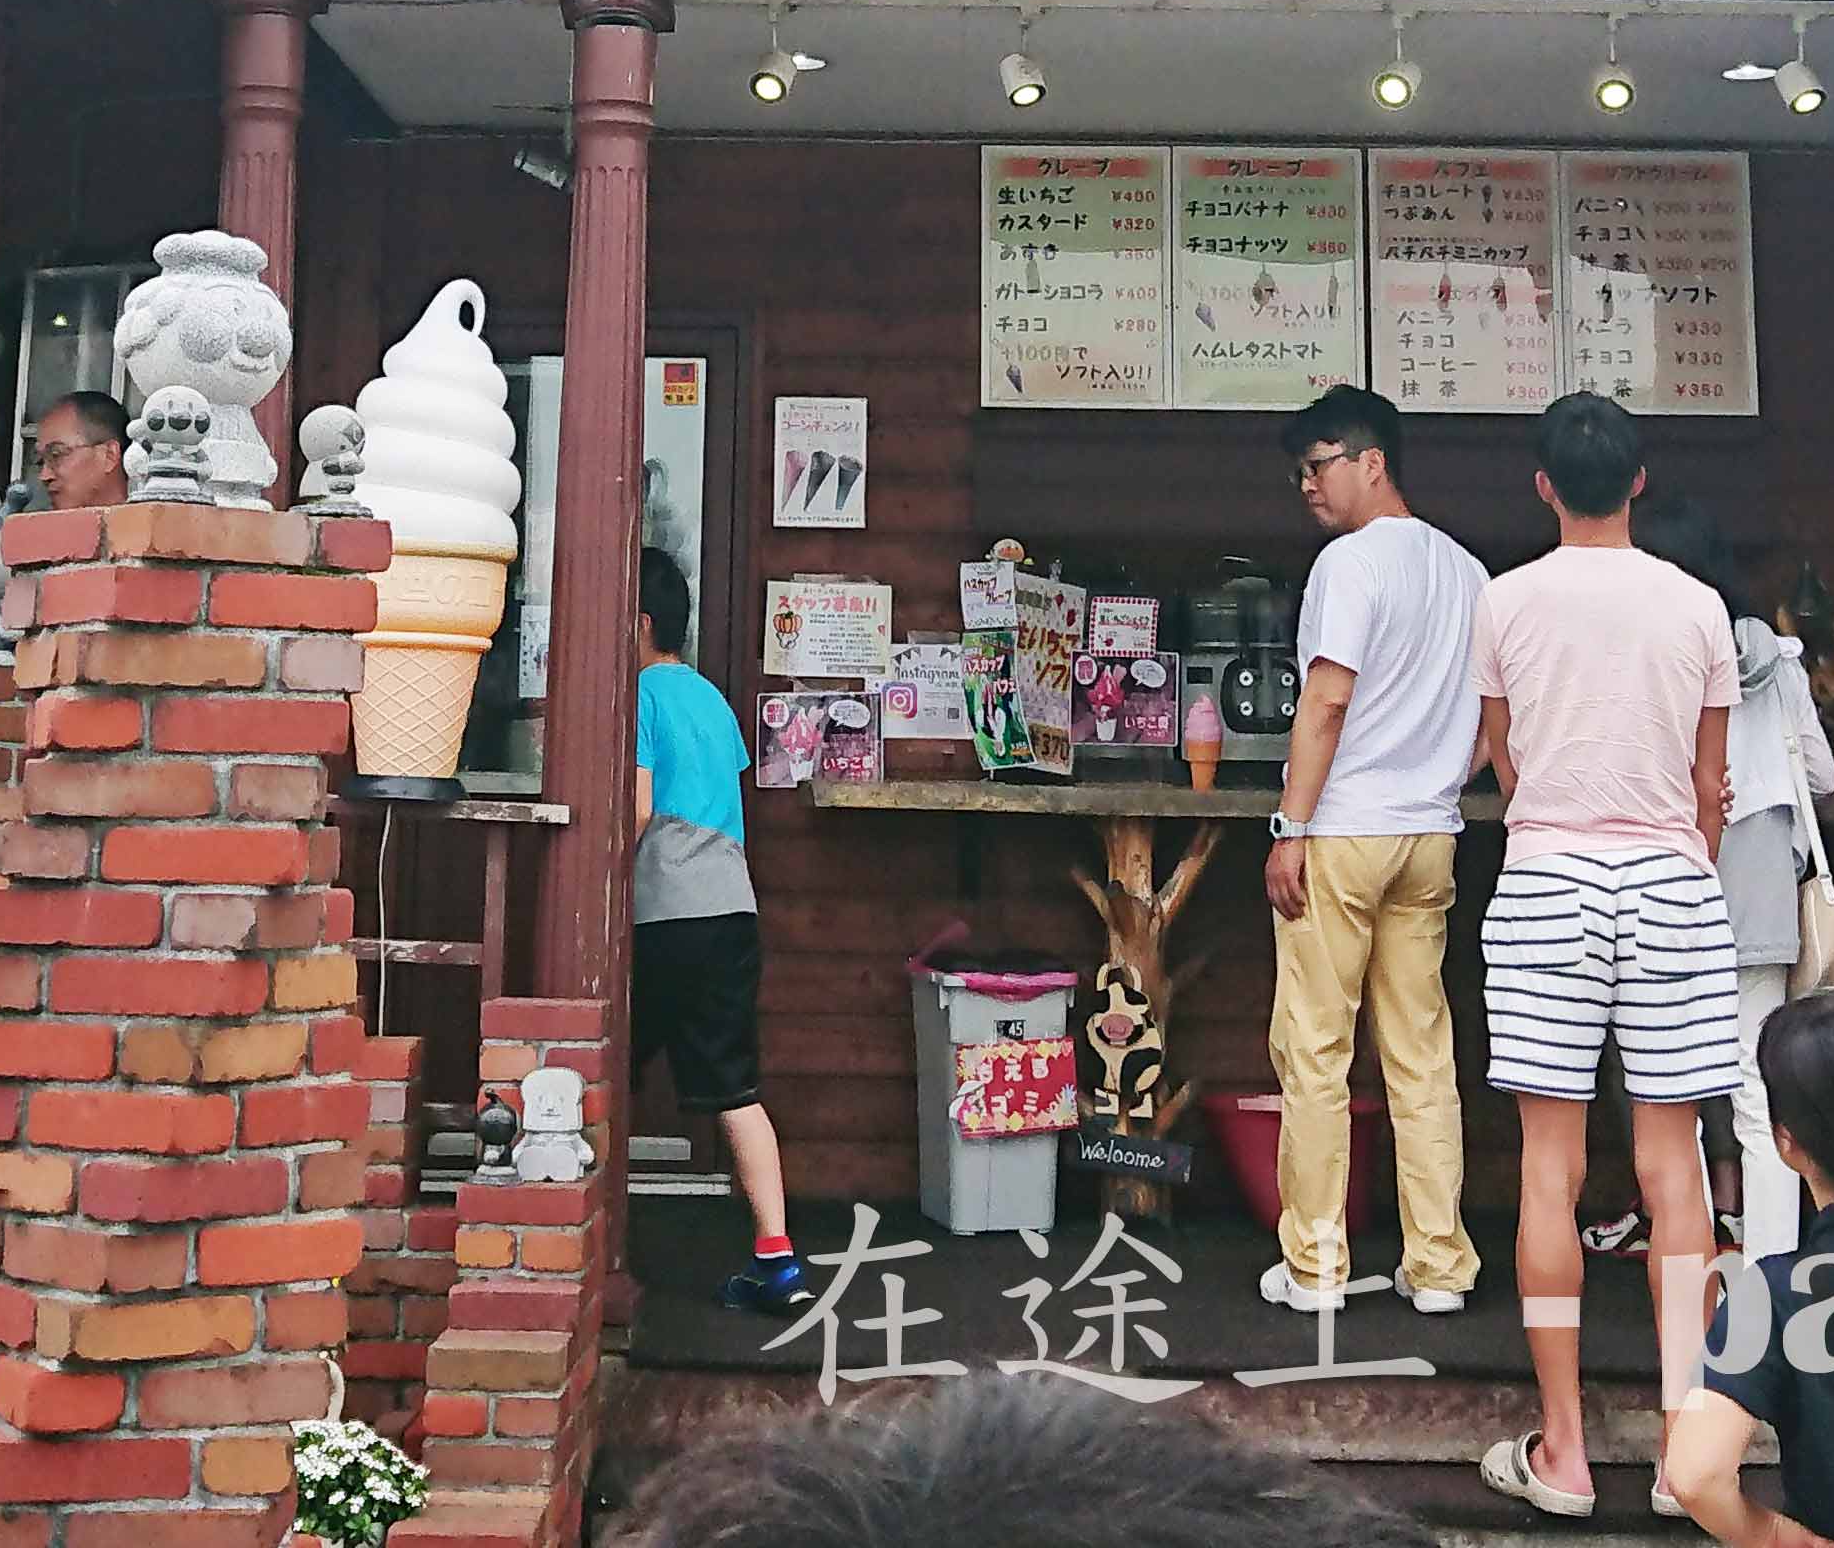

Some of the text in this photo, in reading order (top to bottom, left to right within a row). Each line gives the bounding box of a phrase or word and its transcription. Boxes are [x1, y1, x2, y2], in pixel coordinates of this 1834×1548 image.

[1038, 158, 1109, 175] クレープ
[1228, 159, 1304, 176] クレープ
[998, 186, 1155, 205] 生いちご ¥400
[1383, 185, 1473, 200] チョコレート
[1185, 201, 1289, 218] チョコバナナ
[1384, 206, 1456, 221] つぶあん
[1575, 198, 1628, 213] バニラ
[998, 214, 1155, 232] カスタード ¥320
[1575, 226, 1631, 242] チョコ
[1187, 236, 1288, 253] チョコナッツ
[996, 283, 1103, 300] ガトーショコラ
[996, 317, 1048, 332] チョコ
[1397, 311, 1455, 326] バニラ
[1398, 333, 1455, 349] チョコ
[1191, 342, 1324, 360] ハムレタストマト
[1575, 349, 1632, 364] チョコ
[1400, 357, 1478, 372] コーヒー
[1008, 1022, 1023, 1036] 45
[990, 1088, 1039, 1113] ゴミ
